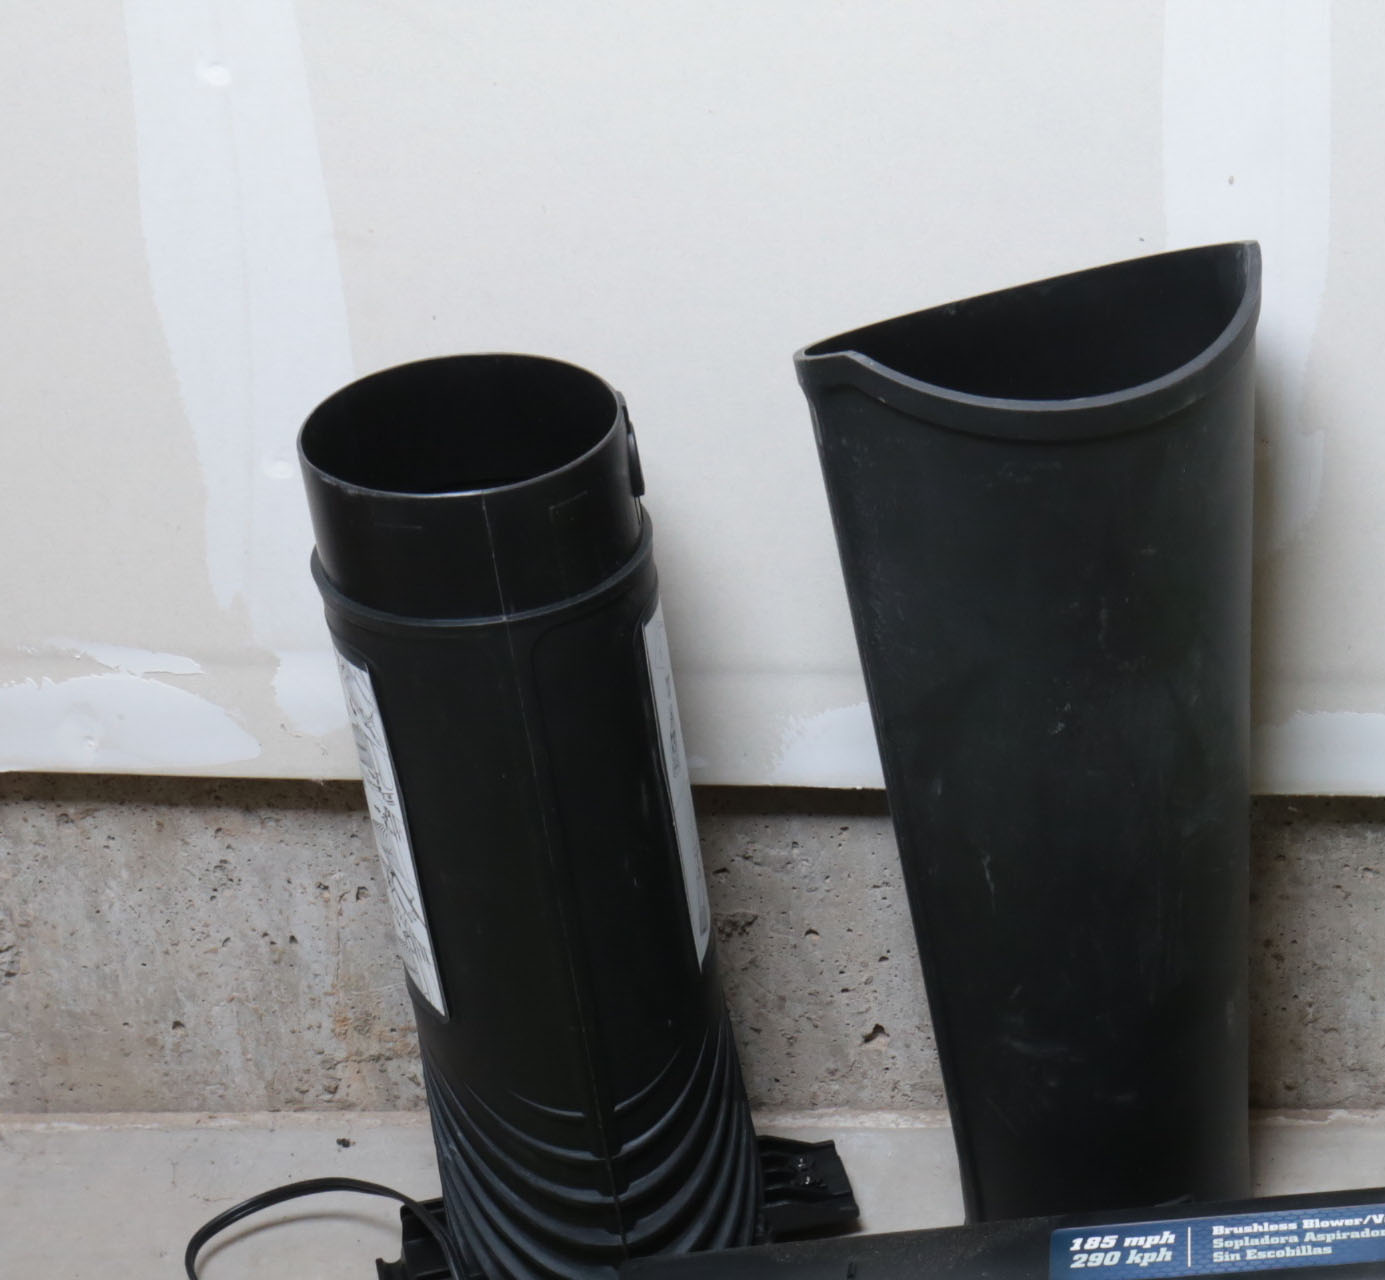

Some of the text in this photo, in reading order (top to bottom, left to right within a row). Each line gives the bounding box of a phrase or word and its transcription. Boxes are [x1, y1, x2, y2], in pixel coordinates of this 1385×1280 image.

[1212, 1222, 1298, 1236] Brushless
[1069, 1230, 1176, 1251] 185 mph
[1212, 1234, 1299, 1250] Sopladora
[1069, 1247, 1173, 1268] 290 kph
[1212, 1244, 1333, 1263] Sin Escobillas
